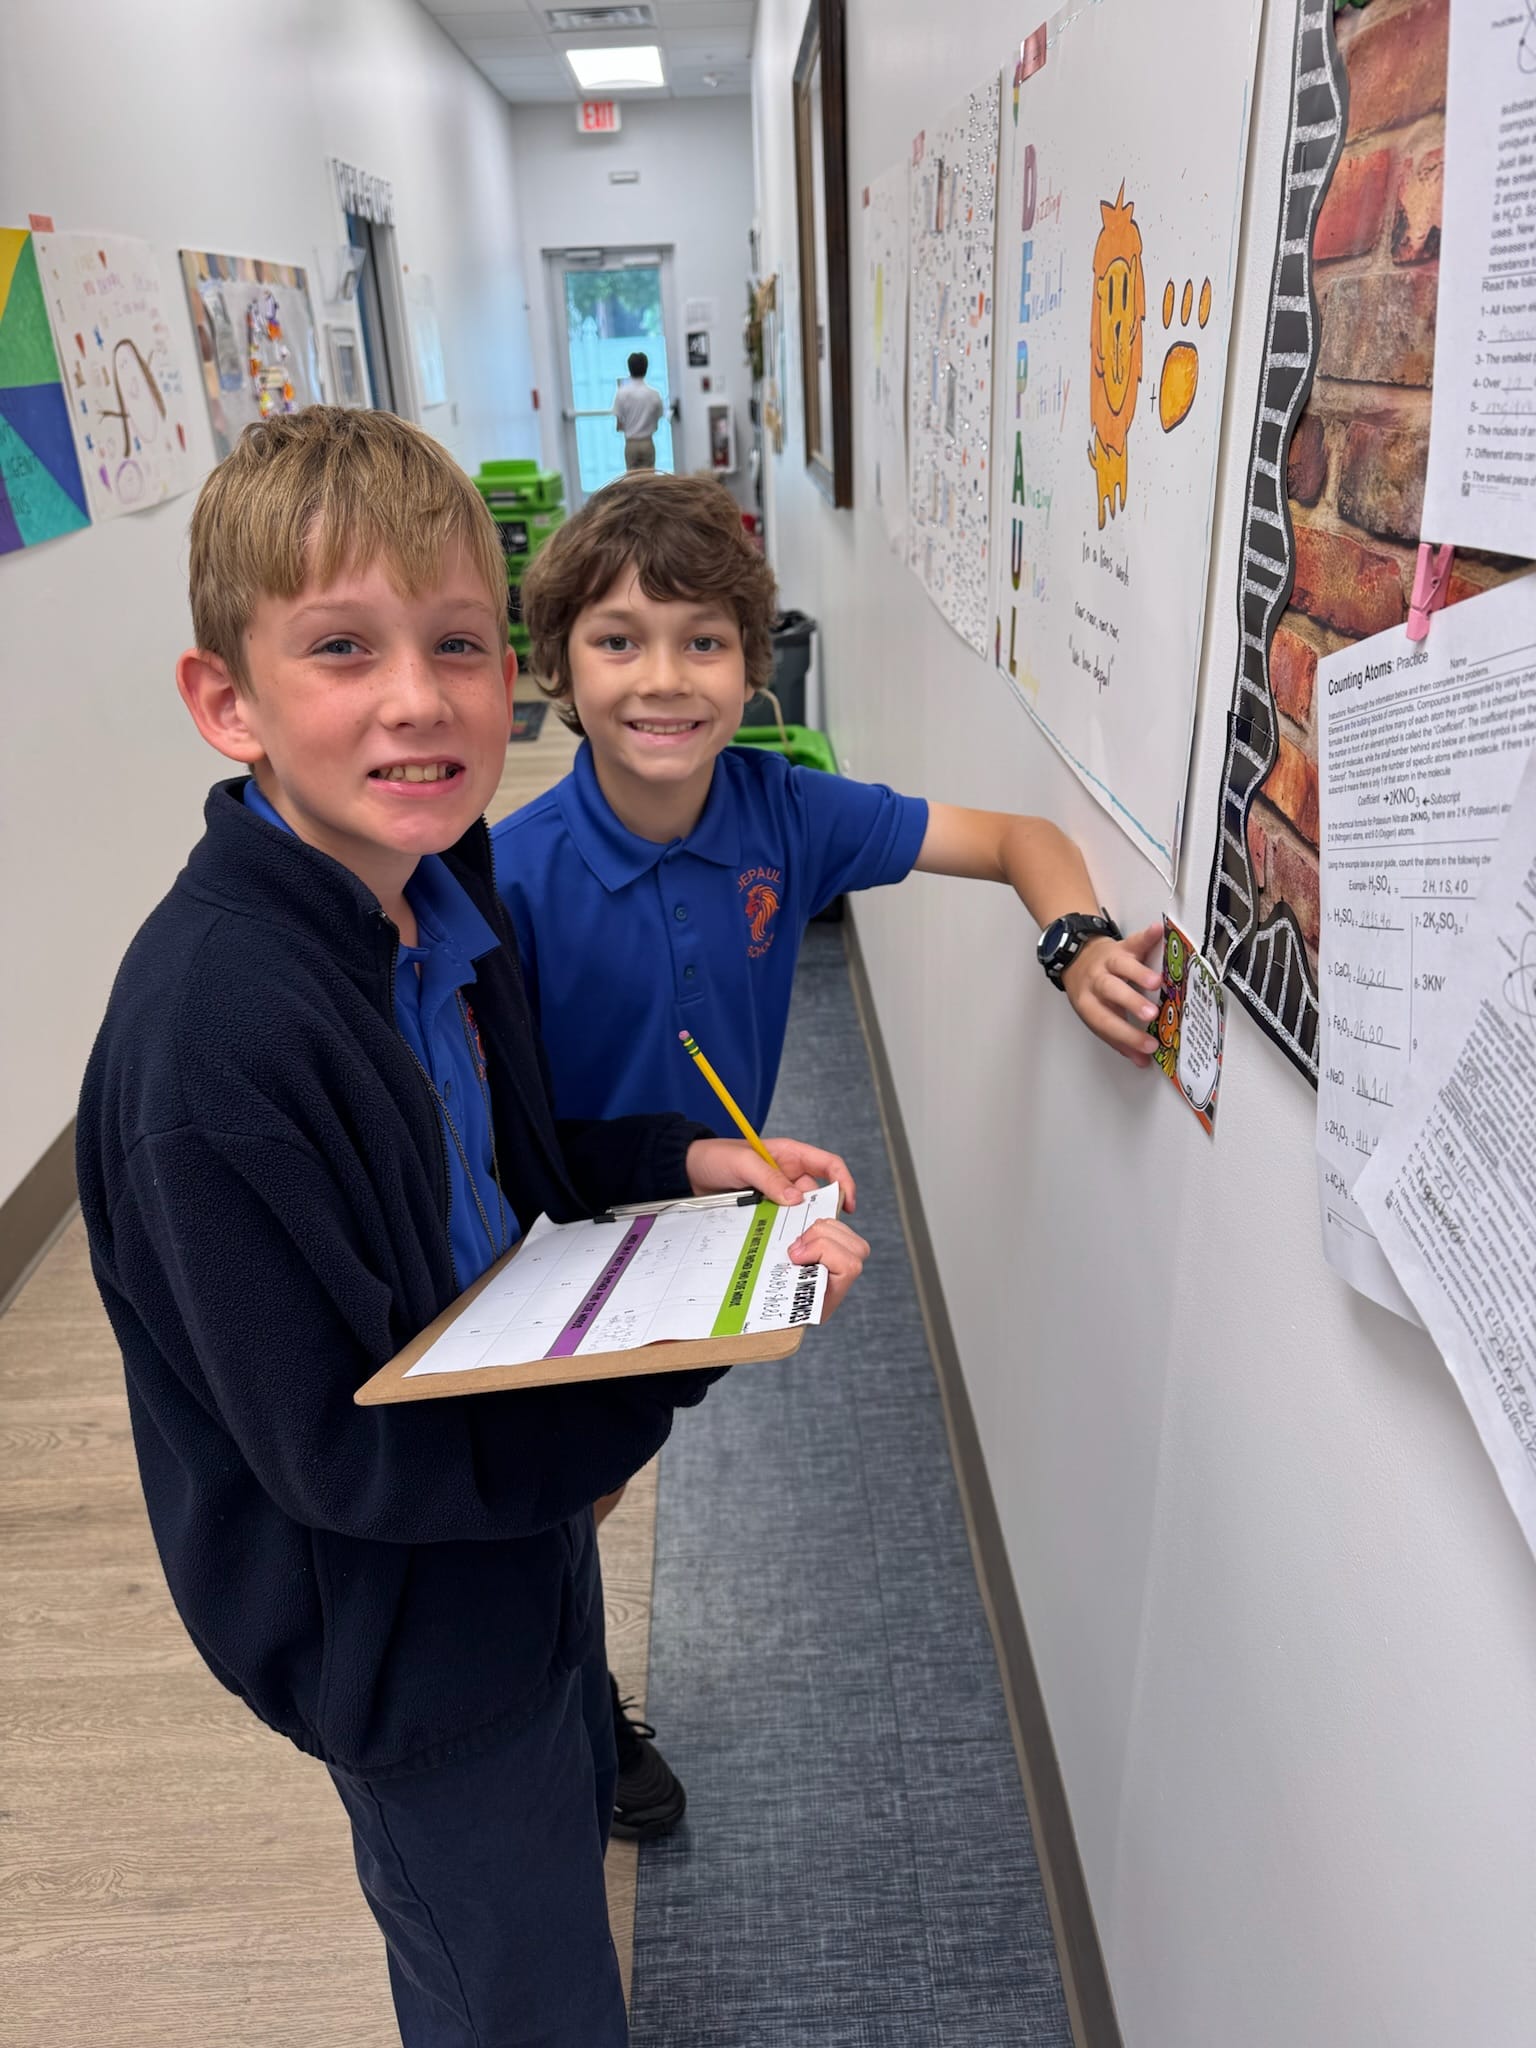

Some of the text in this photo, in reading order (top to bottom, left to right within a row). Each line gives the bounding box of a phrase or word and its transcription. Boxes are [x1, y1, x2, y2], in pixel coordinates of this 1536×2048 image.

[583, 101, 615, 131] EXIT
[1481, 278, 1519, 293] Read the
[1489, 303, 1501, 316] All
[1502, 304, 1527, 315] known
[1485, 352, 1500, 365] The
[1501, 351, 1532, 364] smallest
[1482, 377, 1501, 389] Over
[1478, 423, 1492, 436] The
[1492, 425, 1518, 437] nucleus
[1474, 446, 1504, 460] Different
[1504, 450, 1523, 461] atoms
[1472, 470, 1485, 483] The
[1449, 656, 1467, 669] Name
[1328, 671, 1363, 696] Counting
[1396, 651, 1429, 671] Practice
[1417, 676, 1521, 711] Compounds are represented by using
[1445, 708, 1457, 720] they
[1422, 726, 1432, 737] the
[1468, 715, 1479, 727] The
[1357, 793, 1381, 807] Coefficient
[1430, 791, 1461, 806] Subscript
[1399, 857, 1414, 867] count
[1414, 857, 1424, 867] the
[1425, 857, 1441, 866] atoms
[1441, 857, 1447, 865] in
[1447, 855, 1457, 865] the
[1457, 855, 1481, 868] following
[1419, 1150, 1433, 1172] Over
[1445, 1124, 1464, 1153] known
[1462, 1152, 1488, 1192] elements
[1486, 1191, 1498, 1207] are
[1496, 1205, 1514, 1233] listed
[1511, 1231, 1520, 1245] on
[1519, 1243, 1531, 1262] the
[1400, 1186, 1423, 1224] Different
[1419, 1221, 1438, 1250] atoms
[1434, 1247, 1446, 1265] can
[1444, 1264, 1470, 1303] combine
[1407, 1174, 1419, 1194] The
[1440, 1234, 1449, 1246] an
[1447, 1246, 1464, 1271] atom
[1461, 1268, 1485, 1307] contains
[1469, 1236, 1491, 1270] carbon
[1488, 1267, 1507, 1297] atoms
[1394, 1198, 1405, 1217] The
[1402, 1216, 1426, 1252] smallest
[1422, 1249, 1440, 1275] piece
[1446, 1290, 1475, 1337] compound
[1477, 1346, 1495, 1376] called
[788, 1280, 817, 1324] INFERENCES
